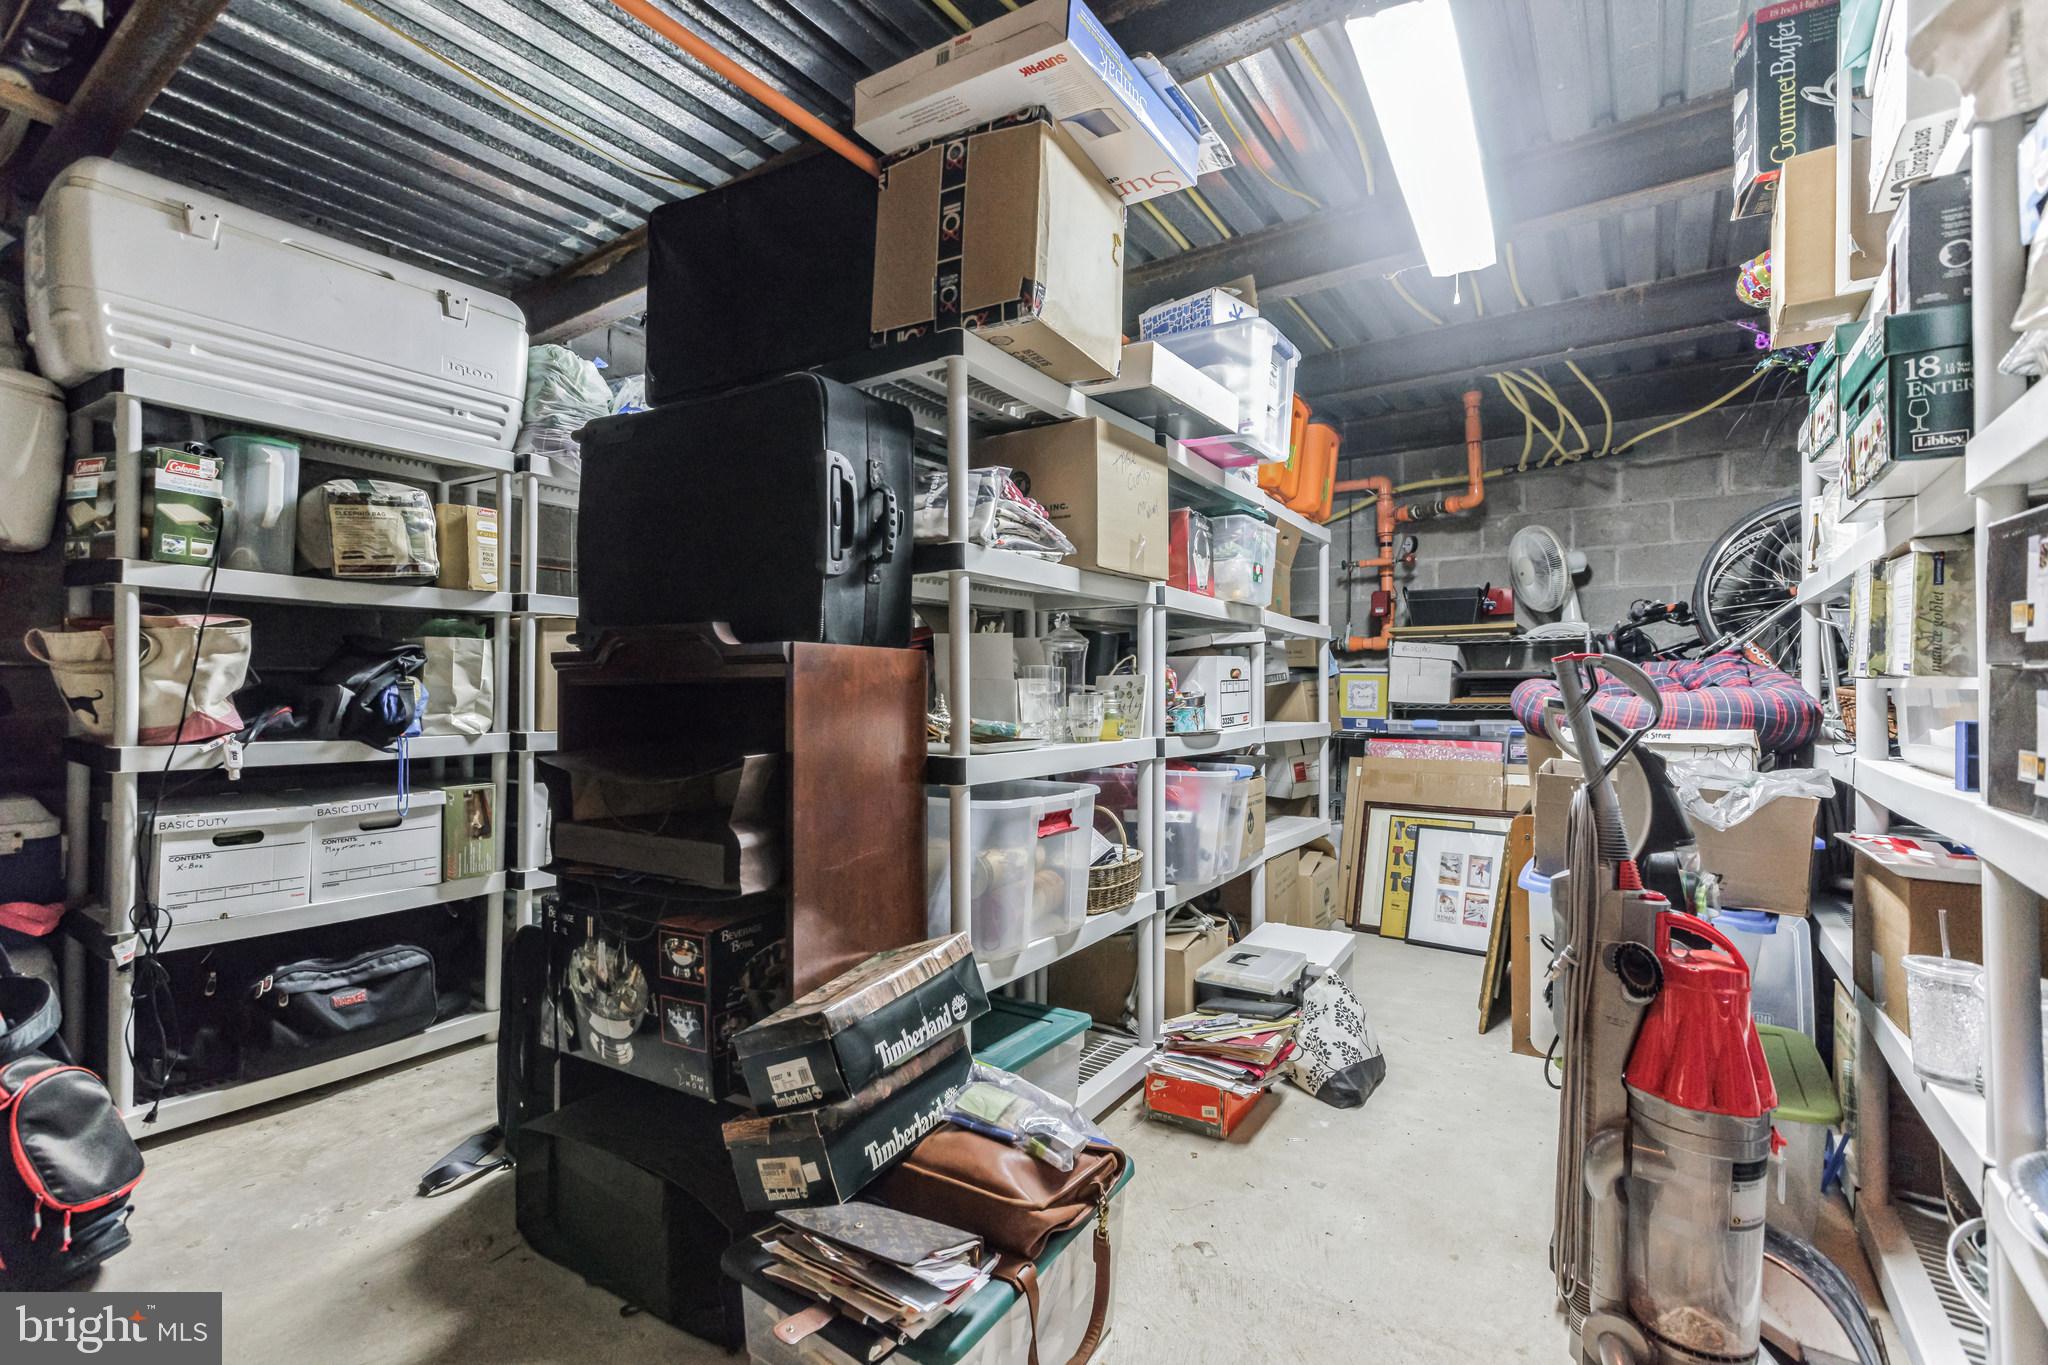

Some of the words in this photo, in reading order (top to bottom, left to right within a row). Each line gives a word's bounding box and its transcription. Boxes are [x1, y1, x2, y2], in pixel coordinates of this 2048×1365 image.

[1904, 355, 1941, 381] 18
[317, 805, 349, 817] BASIC
[351, 802, 379, 812] DUTY
[159, 819, 195, 831] BASIC
[197, 817, 229, 828] DUTY
[874, 1003, 952, 1069] Timberland
[772, 1087, 813, 1109] Timberland
[864, 1097, 944, 1171] Timberland
